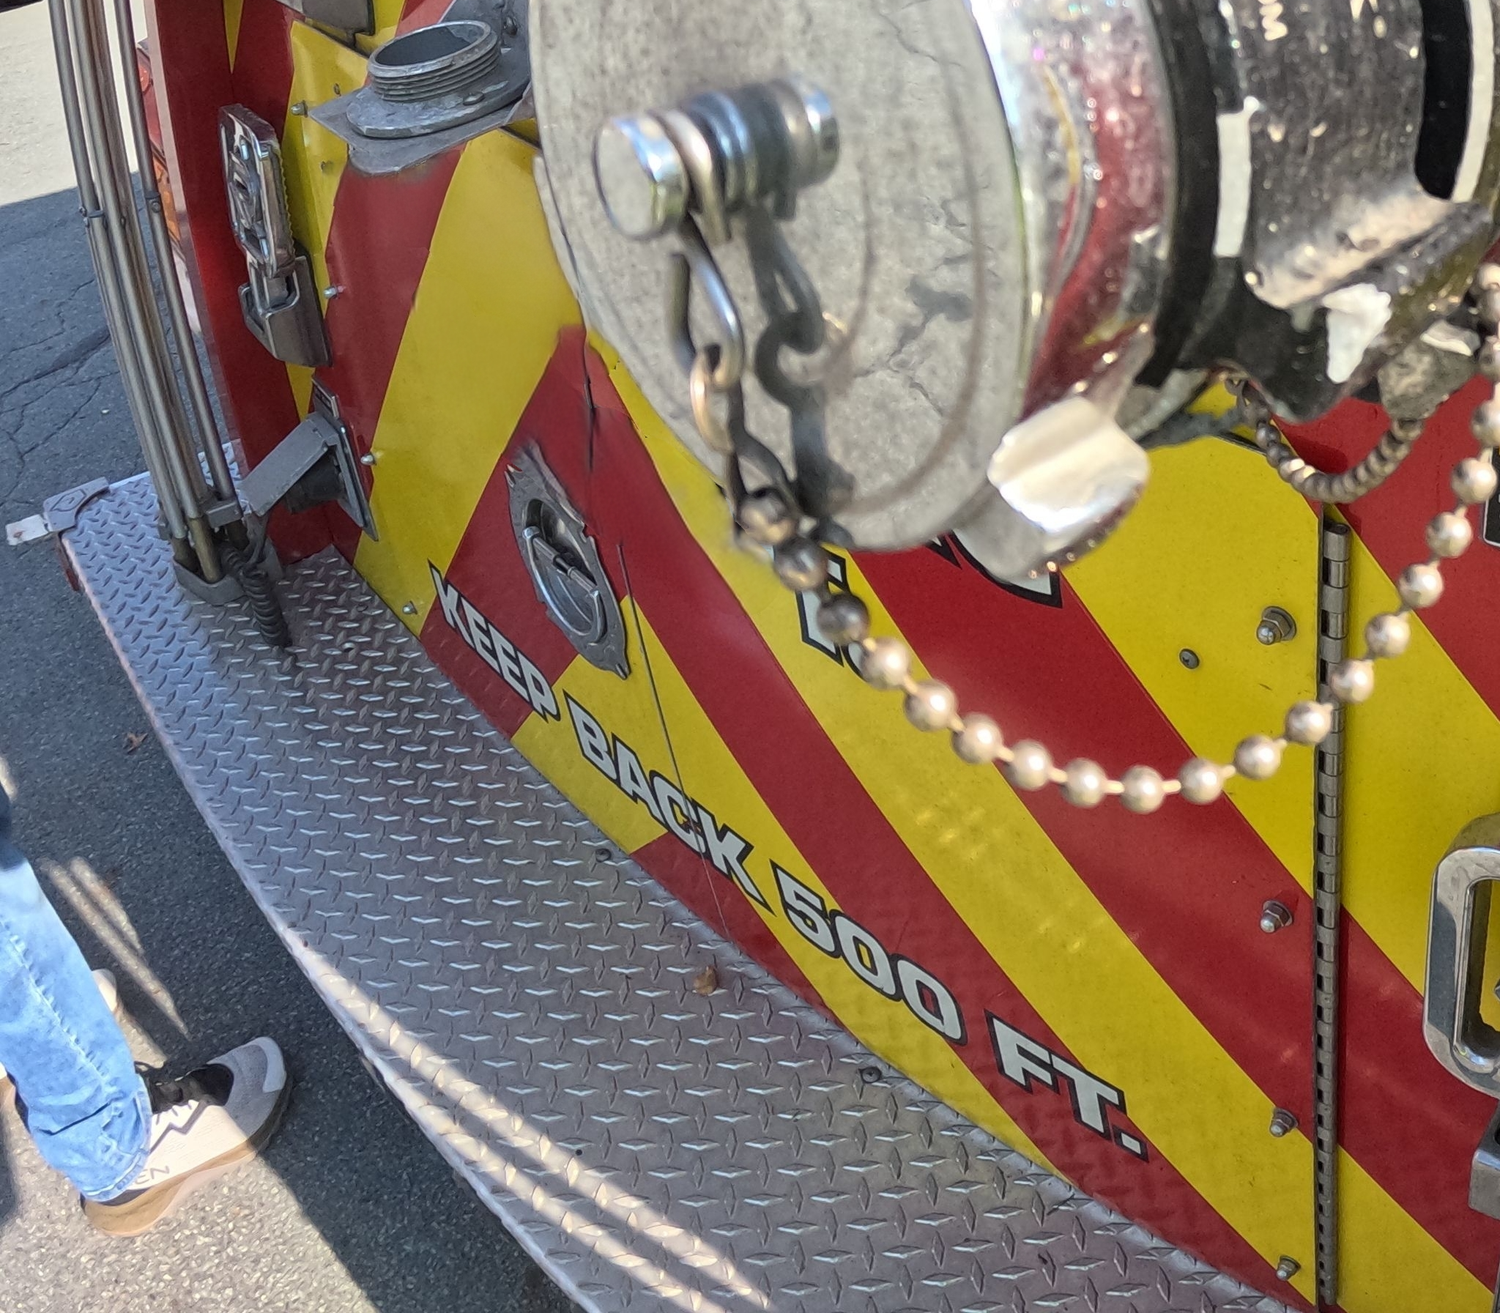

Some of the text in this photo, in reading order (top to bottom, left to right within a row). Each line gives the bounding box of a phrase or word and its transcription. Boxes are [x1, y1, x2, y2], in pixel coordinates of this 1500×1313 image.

[428, 558, 1149, 1163] KEEP BACK 500 FT.
